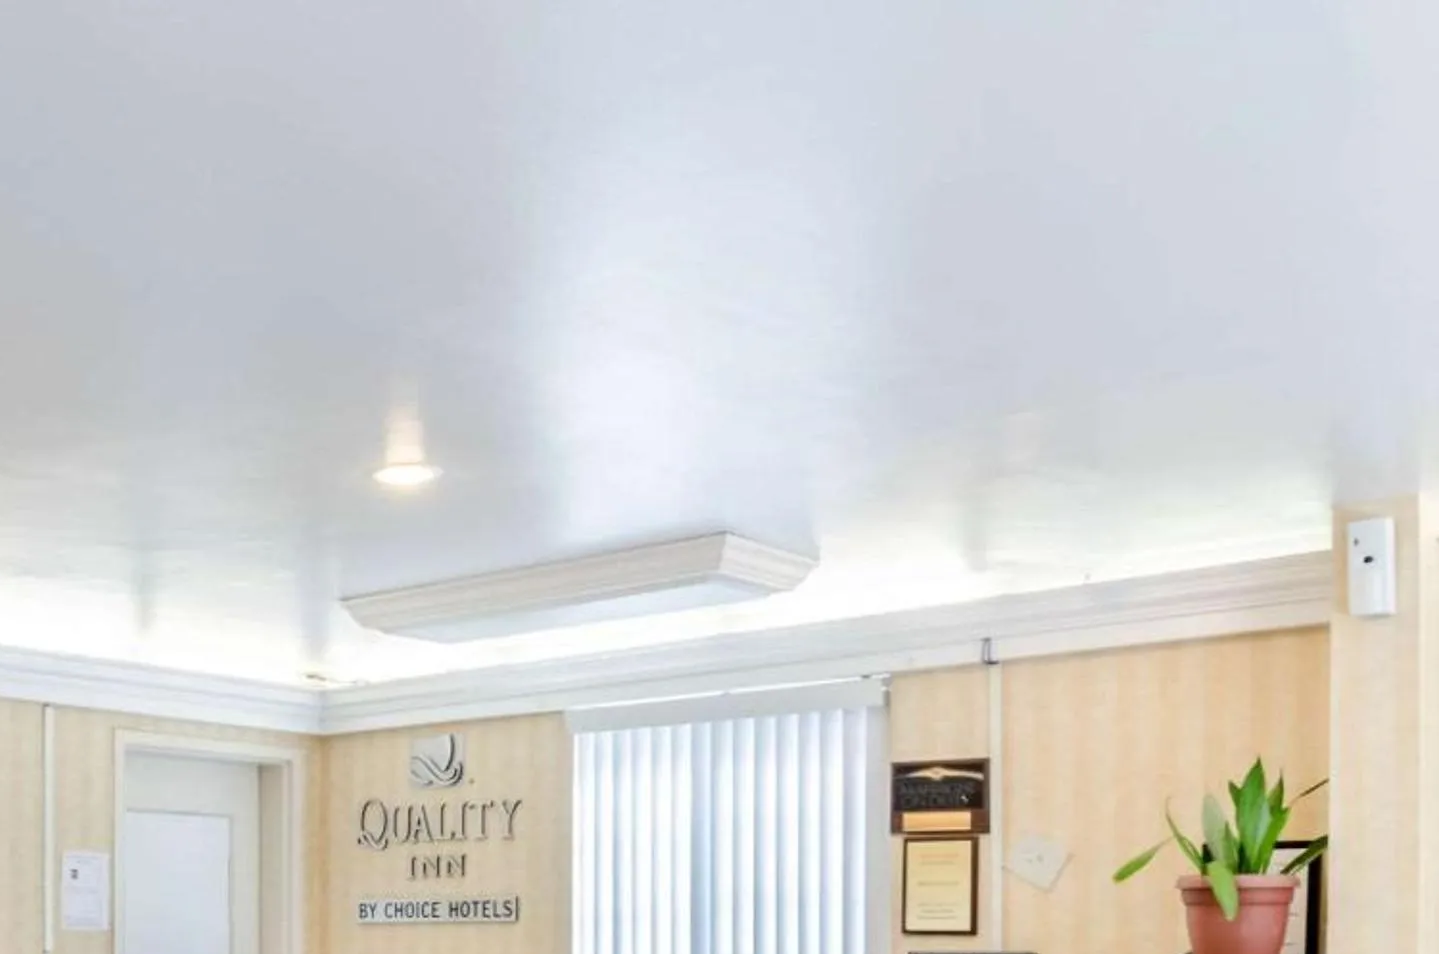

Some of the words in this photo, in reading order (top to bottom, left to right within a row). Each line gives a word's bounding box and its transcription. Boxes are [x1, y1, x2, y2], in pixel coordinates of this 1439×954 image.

[357, 799, 522, 851] QUALITY
[409, 853, 467, 881] INN
[359, 902, 377, 919] BY
[384, 901, 441, 919] CHOICE
[449, 900, 513, 918] HOTELS
